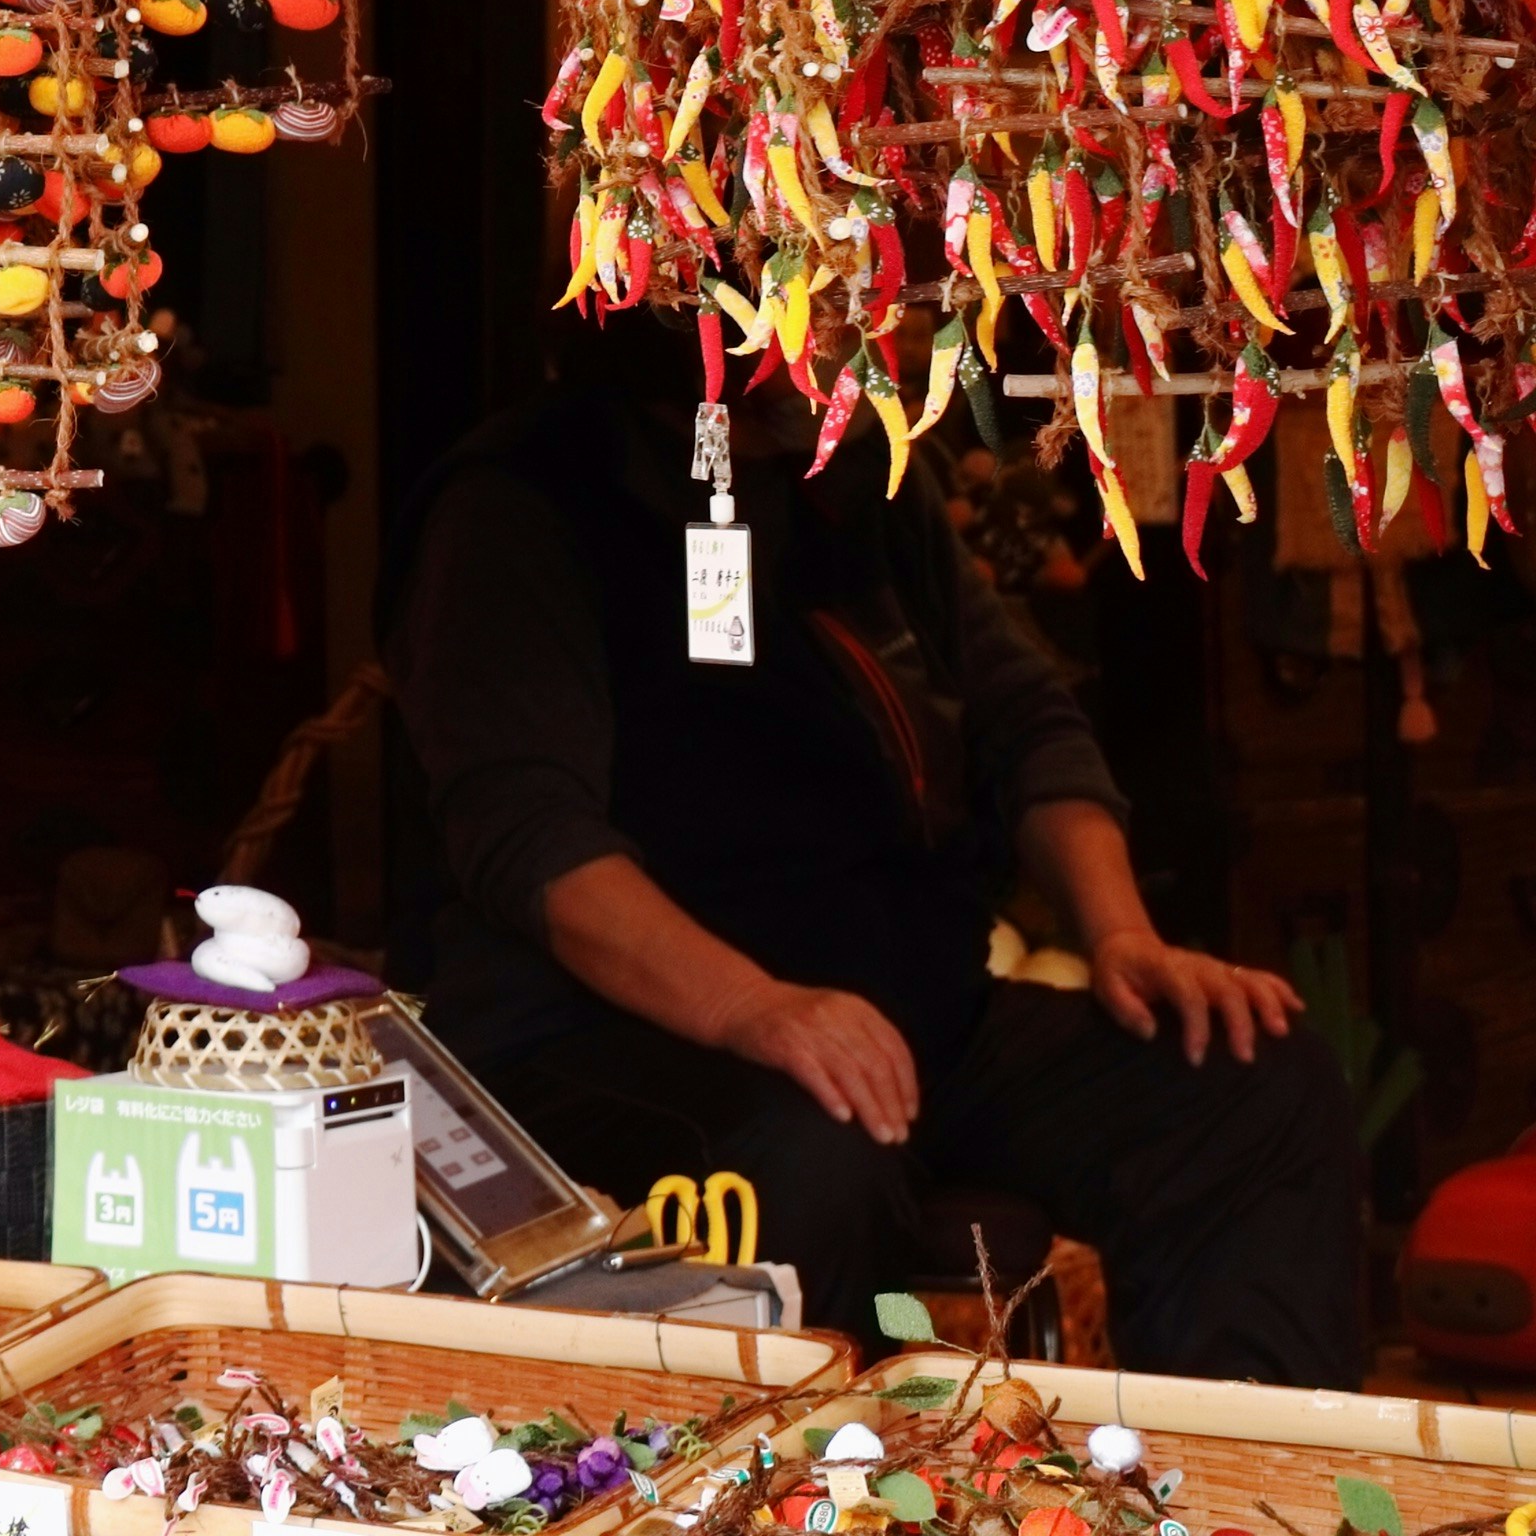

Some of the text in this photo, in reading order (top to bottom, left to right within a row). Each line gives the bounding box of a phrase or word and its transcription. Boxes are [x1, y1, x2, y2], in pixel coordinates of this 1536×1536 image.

[64, 1094, 263, 1129] レジ袋 有料化にご協力ください
[99, 1194, 133, 1224] 3円
[194, 1192, 241, 1232] 5円
